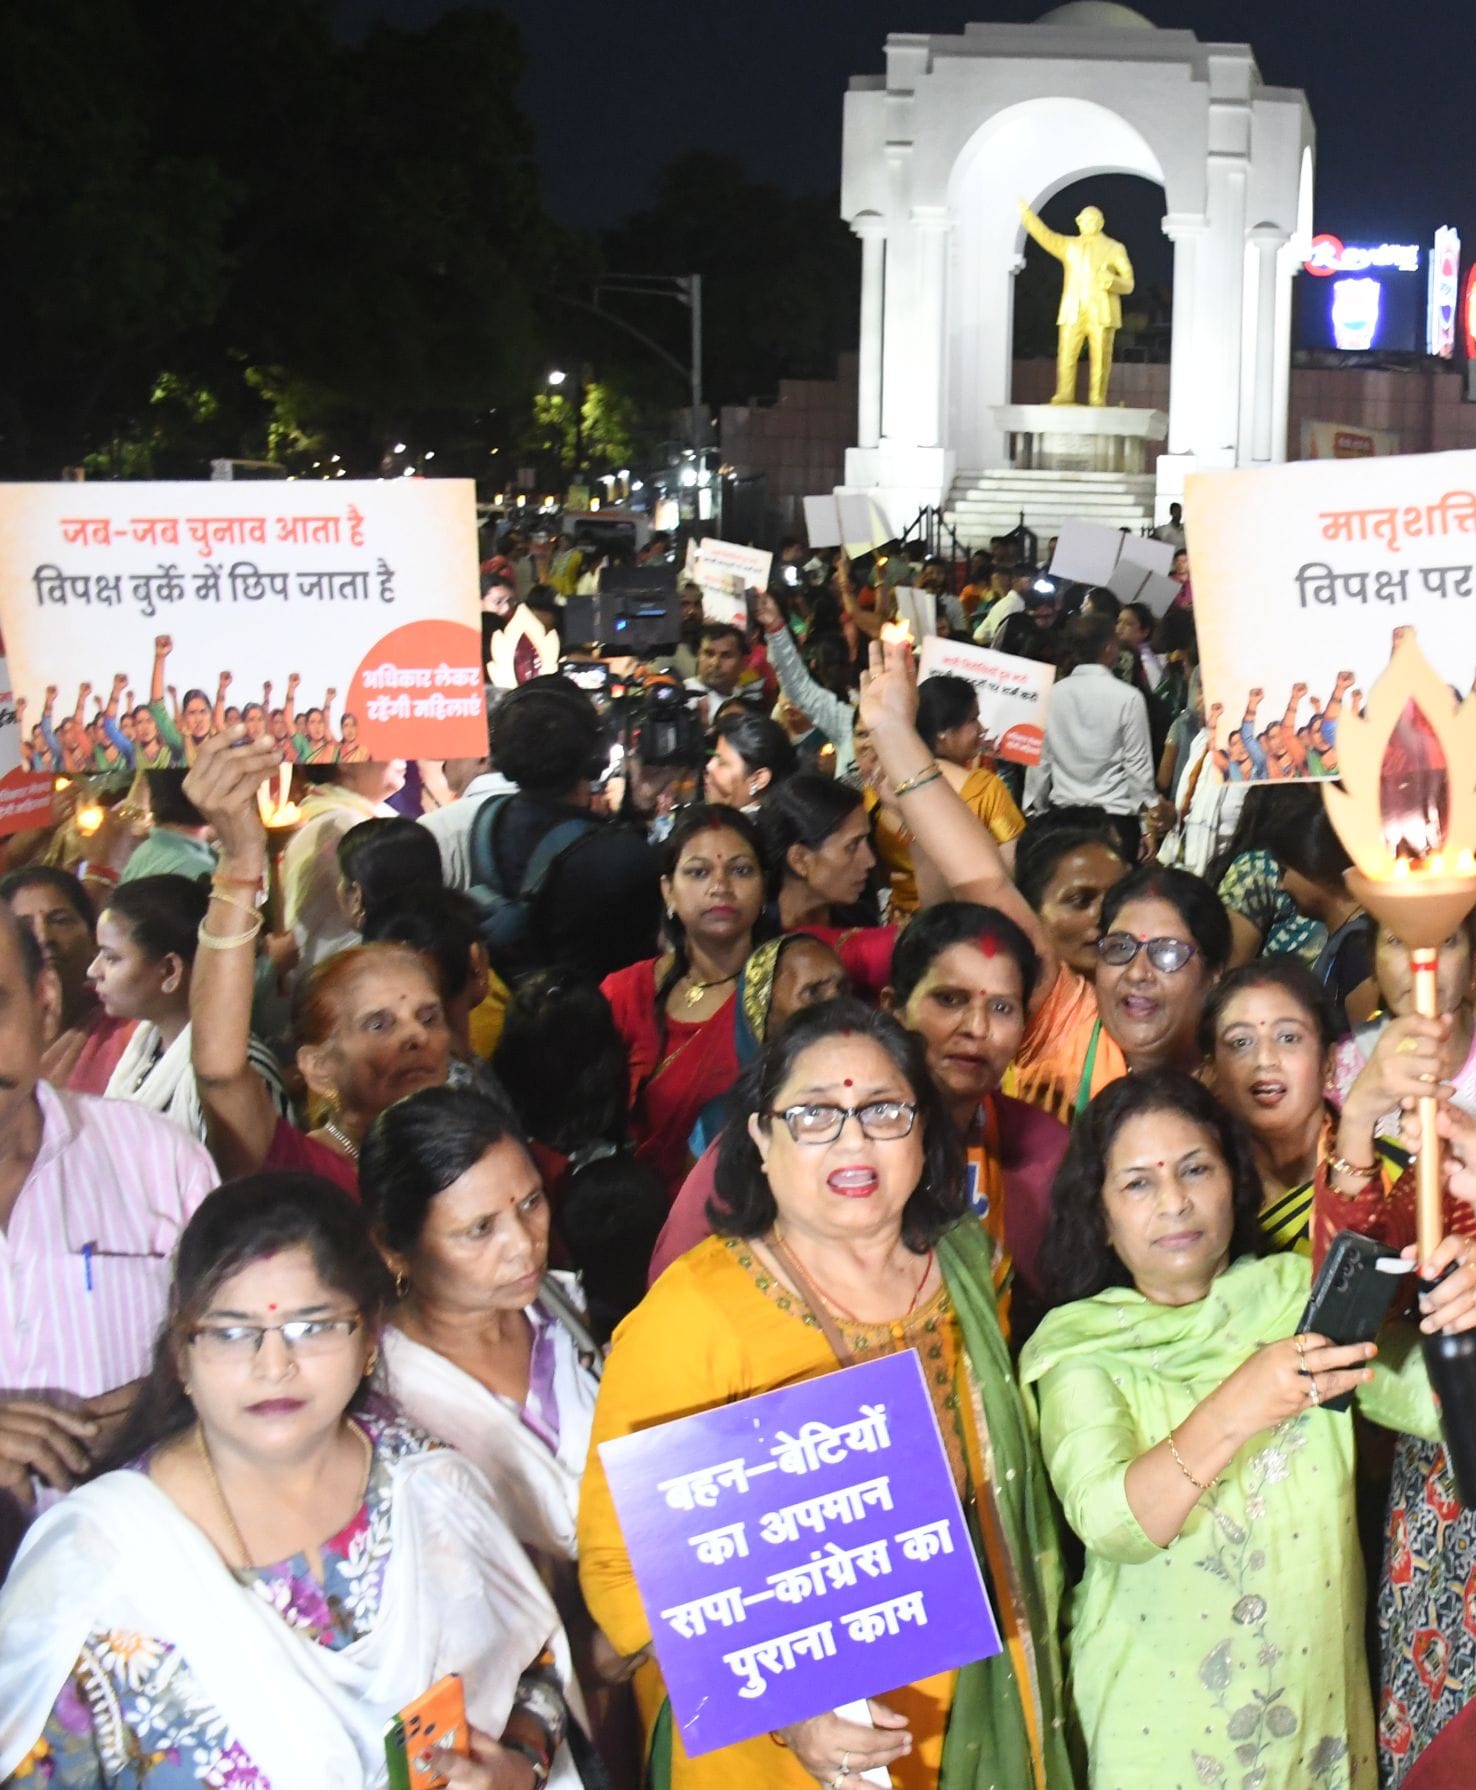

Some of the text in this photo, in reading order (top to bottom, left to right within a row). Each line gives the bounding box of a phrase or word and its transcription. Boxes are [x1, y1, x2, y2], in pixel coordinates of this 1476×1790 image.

[60, 502, 366, 558] जब-जब चुनाव आता है
[32, 557, 397, 617] विपक्ष बुर्के में छिप जाता है
[1294, 562, 1409, 608] विपक्ष
[1419, 564, 1474, 599] पर
[687, 1474, 896, 1567] का अपमान
[894, 1517, 955, 1562] का
[722, 1589, 930, 1700] पुराना काम
